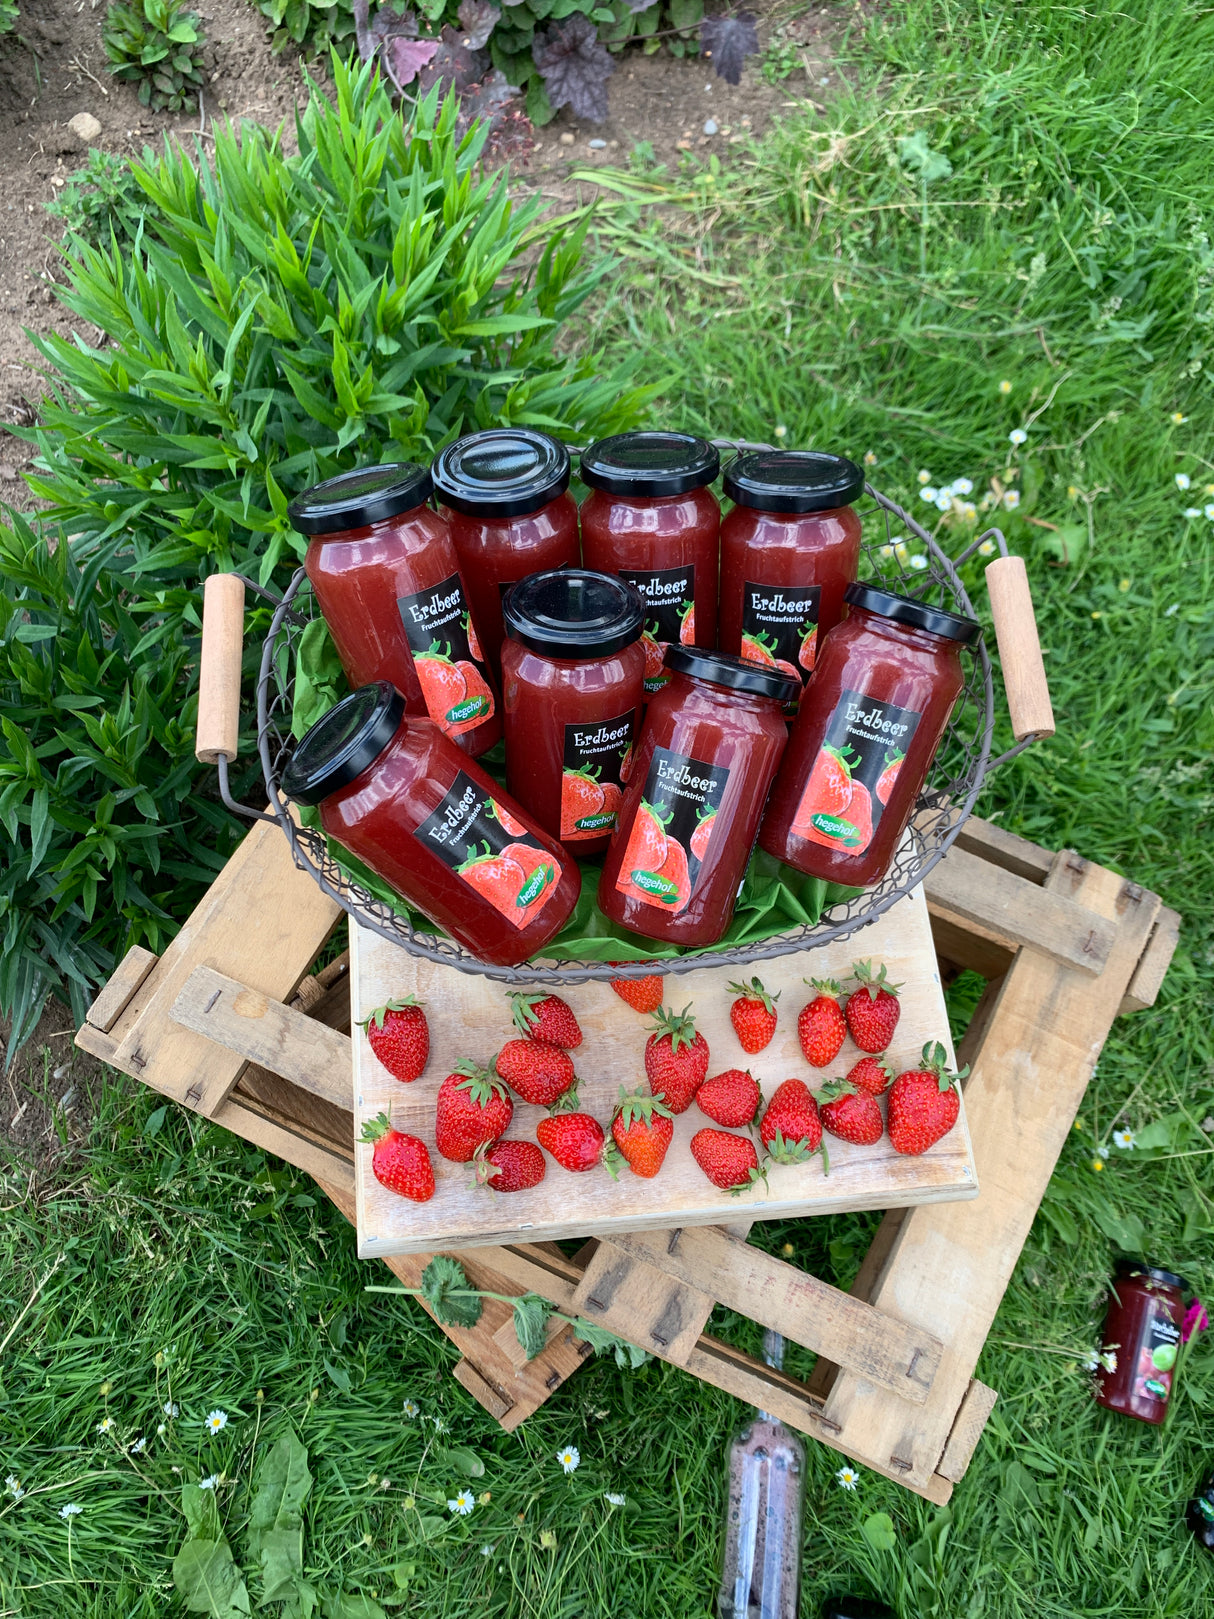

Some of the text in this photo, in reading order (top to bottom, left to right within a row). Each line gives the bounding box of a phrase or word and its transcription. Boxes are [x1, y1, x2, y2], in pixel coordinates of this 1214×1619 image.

[629, 578, 687, 596] rdbeer
[408, 589, 461, 623] Erdbeer
[751, 593, 812, 613] Erdbeer
[421, 608, 462, 632] Fruchtaufstrich
[756, 613, 804, 623] Fruchtaufstrich
[452, 696, 482, 720] hegehof
[845, 703, 908, 737] Erdbeer
[574, 723, 630, 747] Erdbeer
[846, 724, 896, 747] Fruchtaufstrich
[579, 740, 624, 755] Fruchtaufstrich
[657, 760, 717, 793] Erdbeer
[658, 781, 706, 803] Fruchtaufstrich
[428, 786, 476, 843] Erdbeer
[449, 803, 483, 846] Fruchtaufstrich
[580, 812, 616, 829] hegehof
[815, 815, 856, 837] hegehof
[519, 866, 546, 905] hegehof
[635, 871, 674, 893] hegehof
